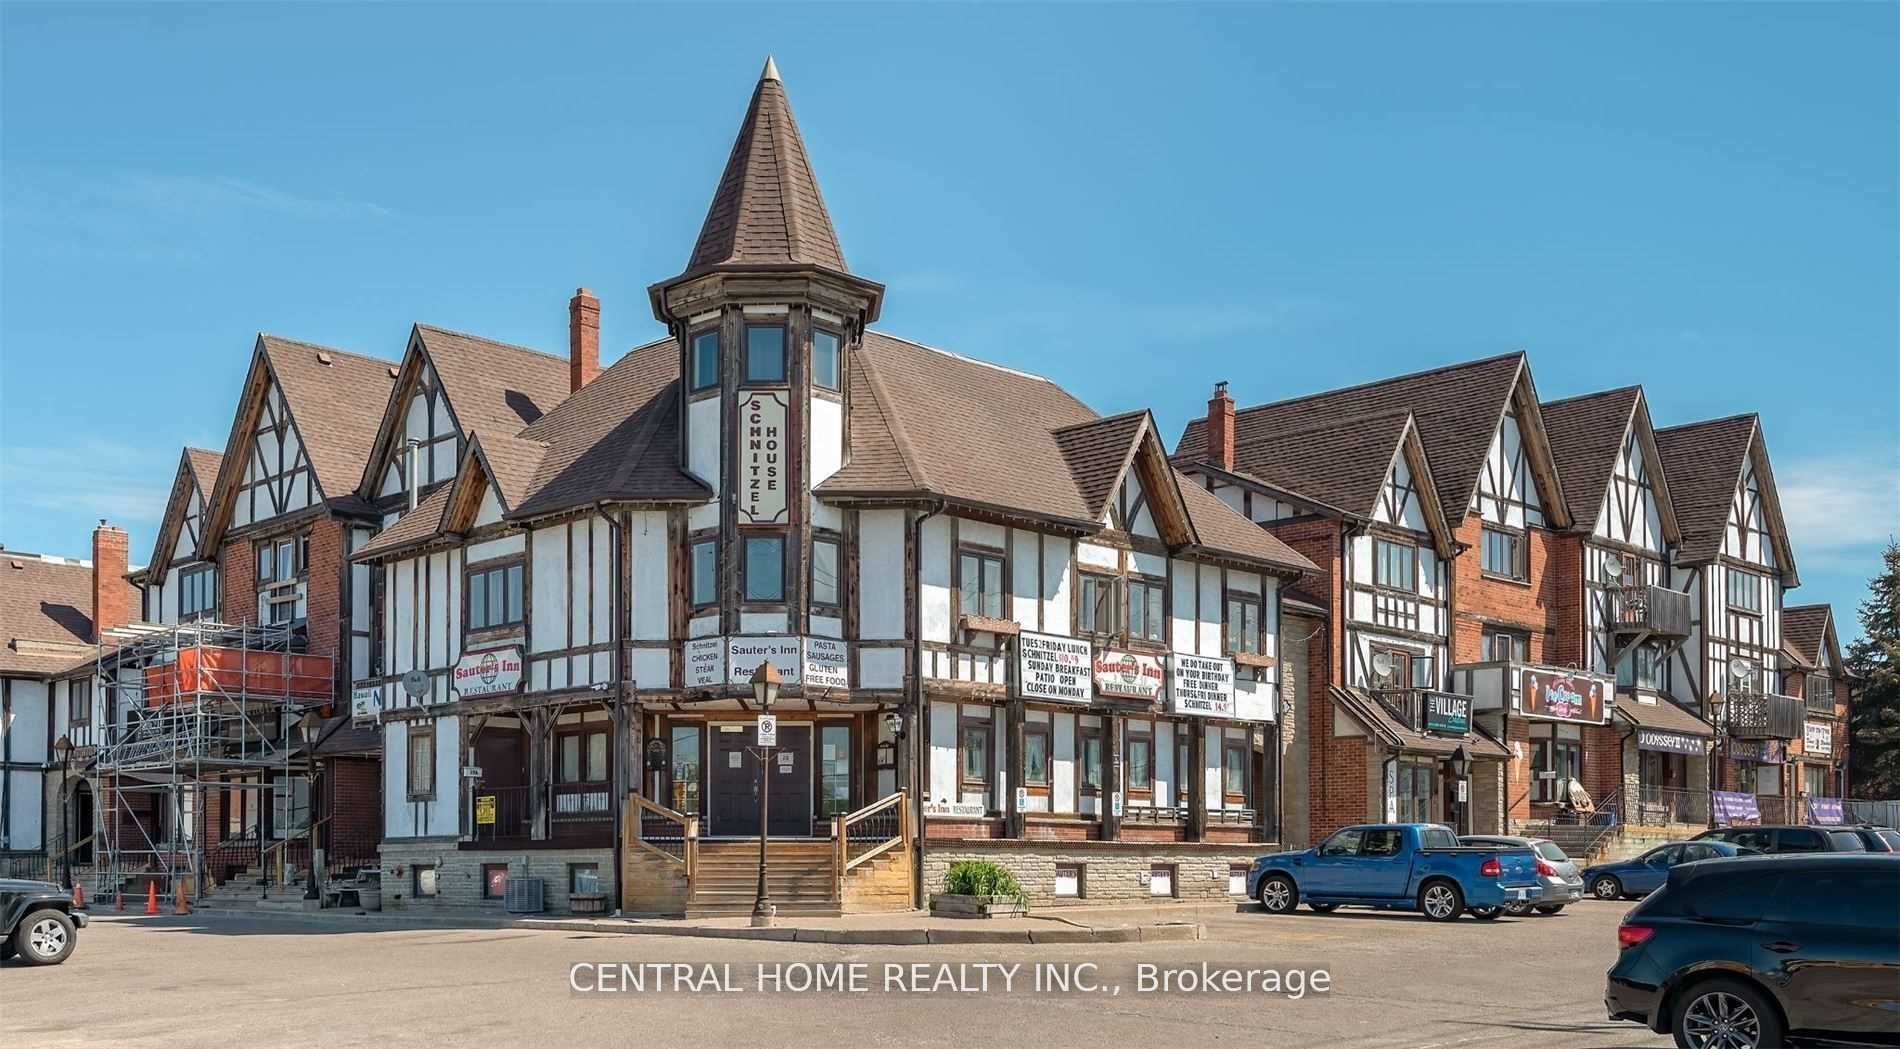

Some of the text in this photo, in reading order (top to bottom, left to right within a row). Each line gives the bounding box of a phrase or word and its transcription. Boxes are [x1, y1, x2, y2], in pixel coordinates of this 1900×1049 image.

[750, 400, 761, 515] SCHNITZEL
[766, 426, 777, 490] HOUSE
[731, 645, 797, 655] Sauter's Inn
[814, 641, 836, 650] PASTA
[691, 653, 718, 662] CHICKEN
[807, 651, 845, 663] SAUSAGES
[1022, 648, 1058, 662] SCHNITZEL
[502, 660, 520, 672] Inn
[809, 664, 838, 674] GLUTEN
[1028, 660, 1091, 677] SUNDAY BREAKFAST
[1142, 663, 1160, 679] Inn
[1181, 658, 1223, 672] WE DO TAKE OUT
[734, 667, 794, 677] Resant
[1176, 668, 1229, 683] ON YOUR BIRTHDAY
[696, 676, 713, 684] VEAL
[805, 674, 824, 684] FREE
[1035, 672, 1076, 686] PATIO OPEN
[1183, 679, 1218, 691] FREE DINNER
[1026, 682, 1085, 697] CLOSE ON MONDAY
[1435, 696, 1467, 718] VILLAGE
